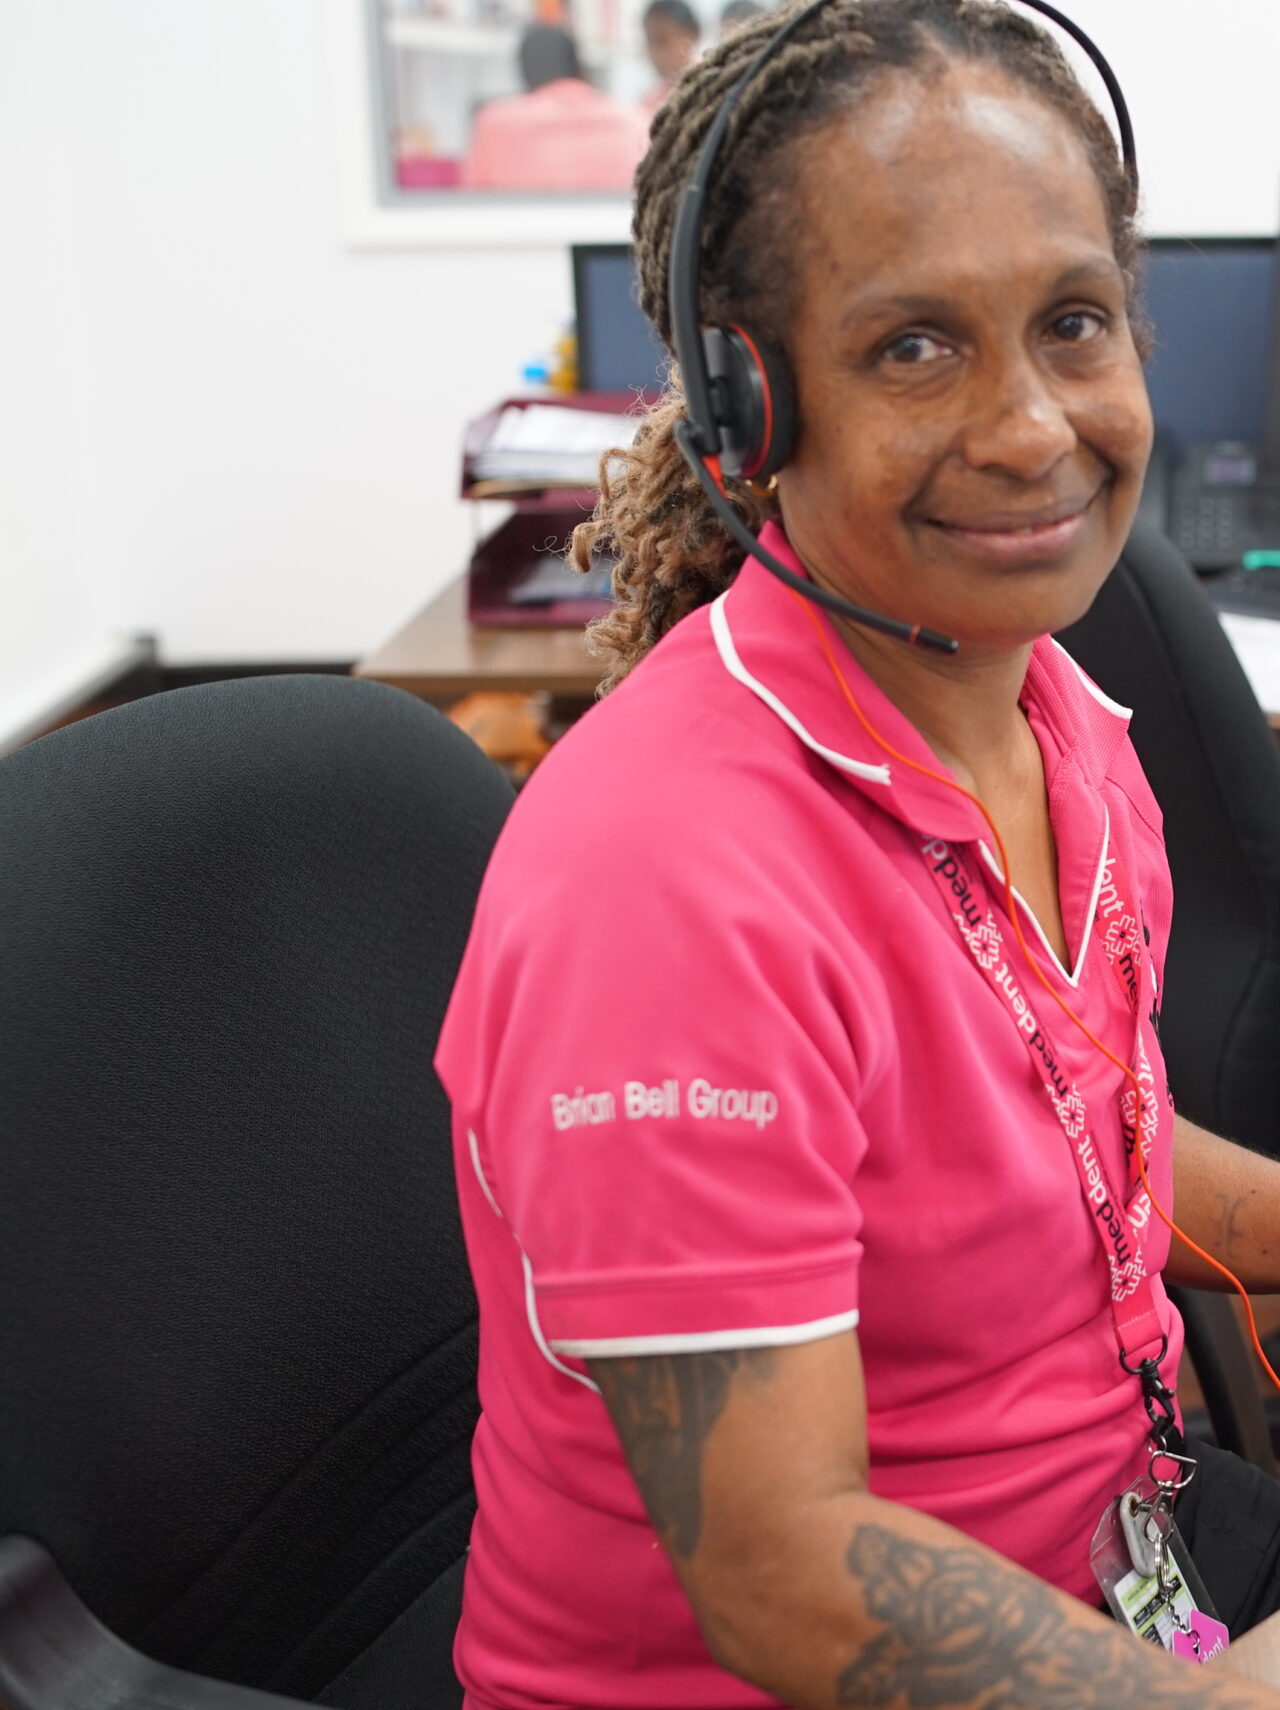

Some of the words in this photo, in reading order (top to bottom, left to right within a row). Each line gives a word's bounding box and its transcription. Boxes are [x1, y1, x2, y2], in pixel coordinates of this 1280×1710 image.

[994, 962, 1068, 1097] meddent
[551, 1086, 616, 1131] Brian
[624, 1079, 680, 1120] Bell
[687, 1078, 778, 1130] Group
[1088, 1135, 1131, 1266] meddent
[1203, 1637, 1224, 1664] dent
